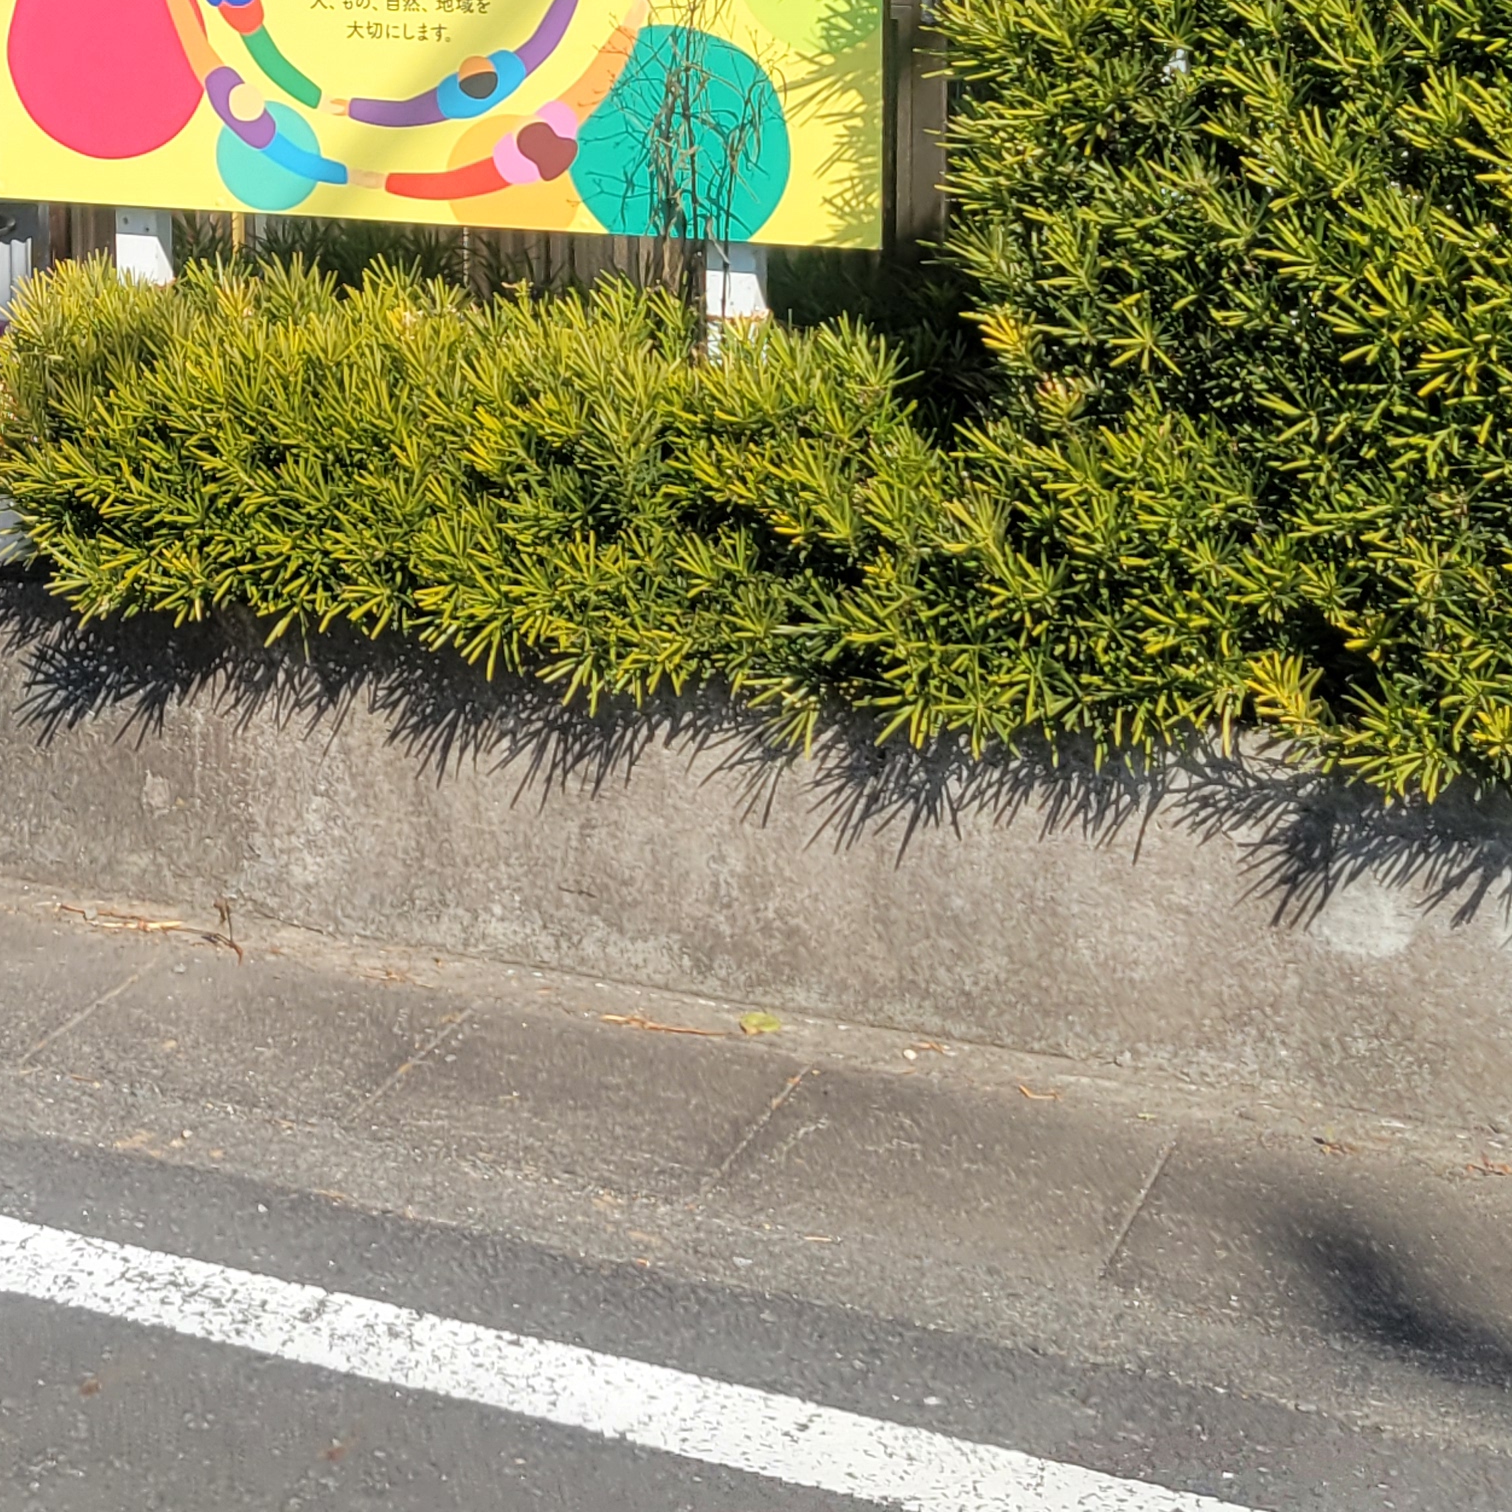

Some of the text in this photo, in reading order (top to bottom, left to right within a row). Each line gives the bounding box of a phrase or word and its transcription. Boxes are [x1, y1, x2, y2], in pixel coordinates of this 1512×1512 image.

[346, 20, 452, 43] 大切にします。
